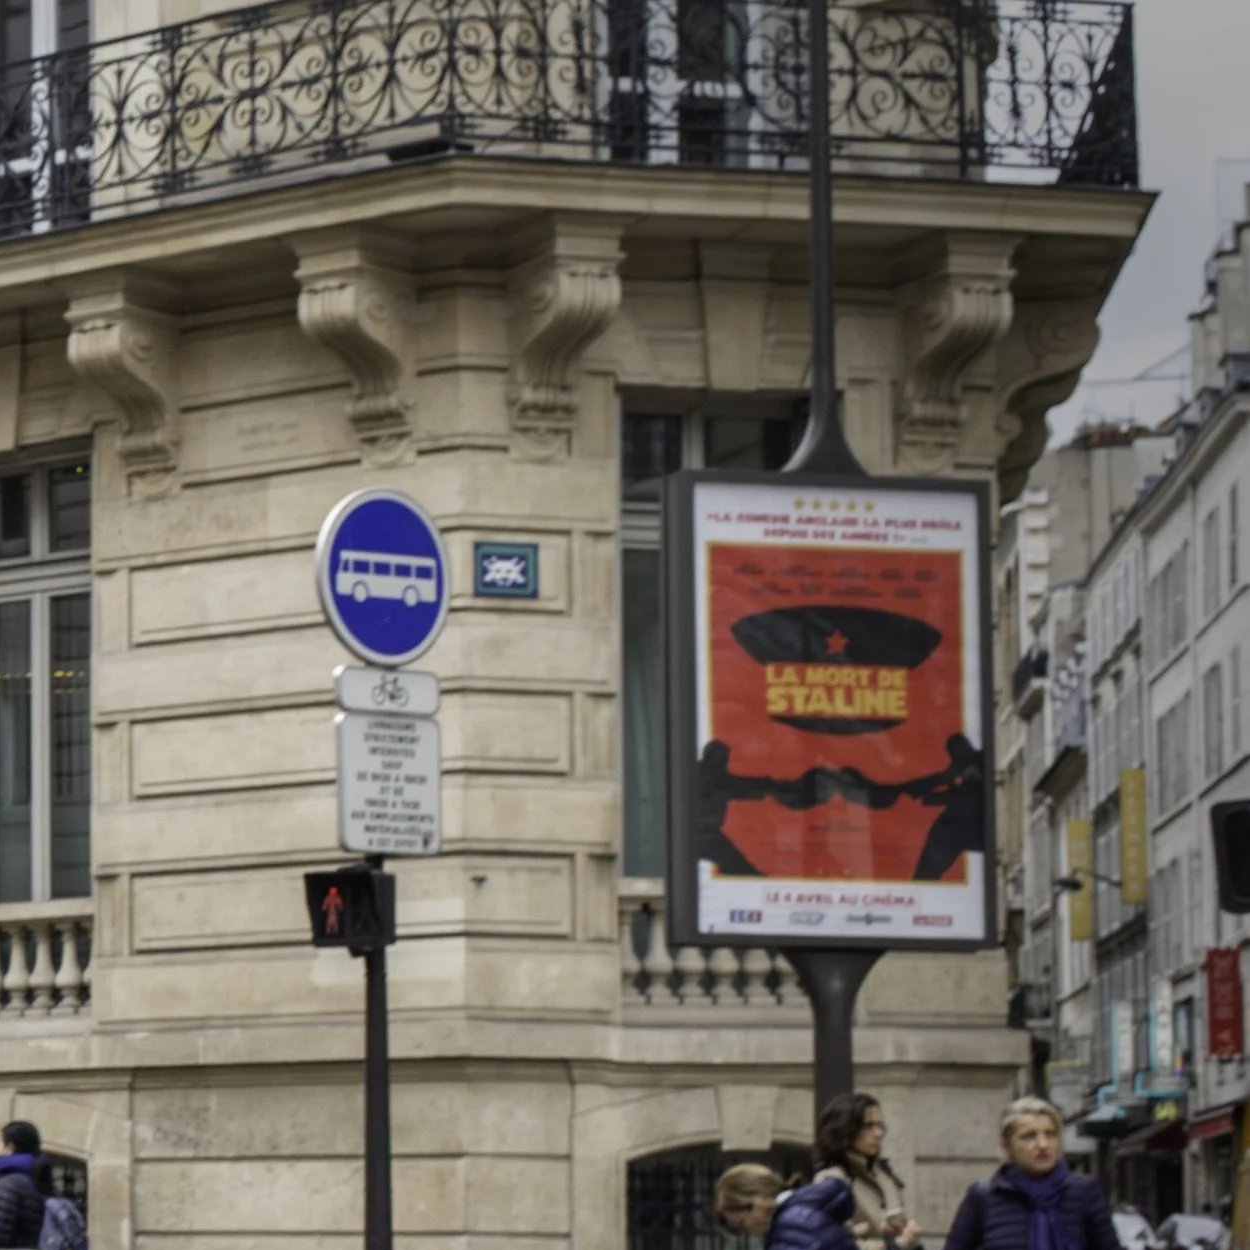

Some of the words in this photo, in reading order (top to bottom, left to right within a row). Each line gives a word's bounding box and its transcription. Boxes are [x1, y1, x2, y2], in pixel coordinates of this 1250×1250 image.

[766, 664, 799, 684] LA
[805, 666, 871, 687] MORT
[877, 668, 908, 689] DE
[766, 685, 908, 718] STALINE
[795, 892, 833, 905] AVRIL
[838, 894, 858, 906] AU
[863, 890, 916, 907] CINÉMA
